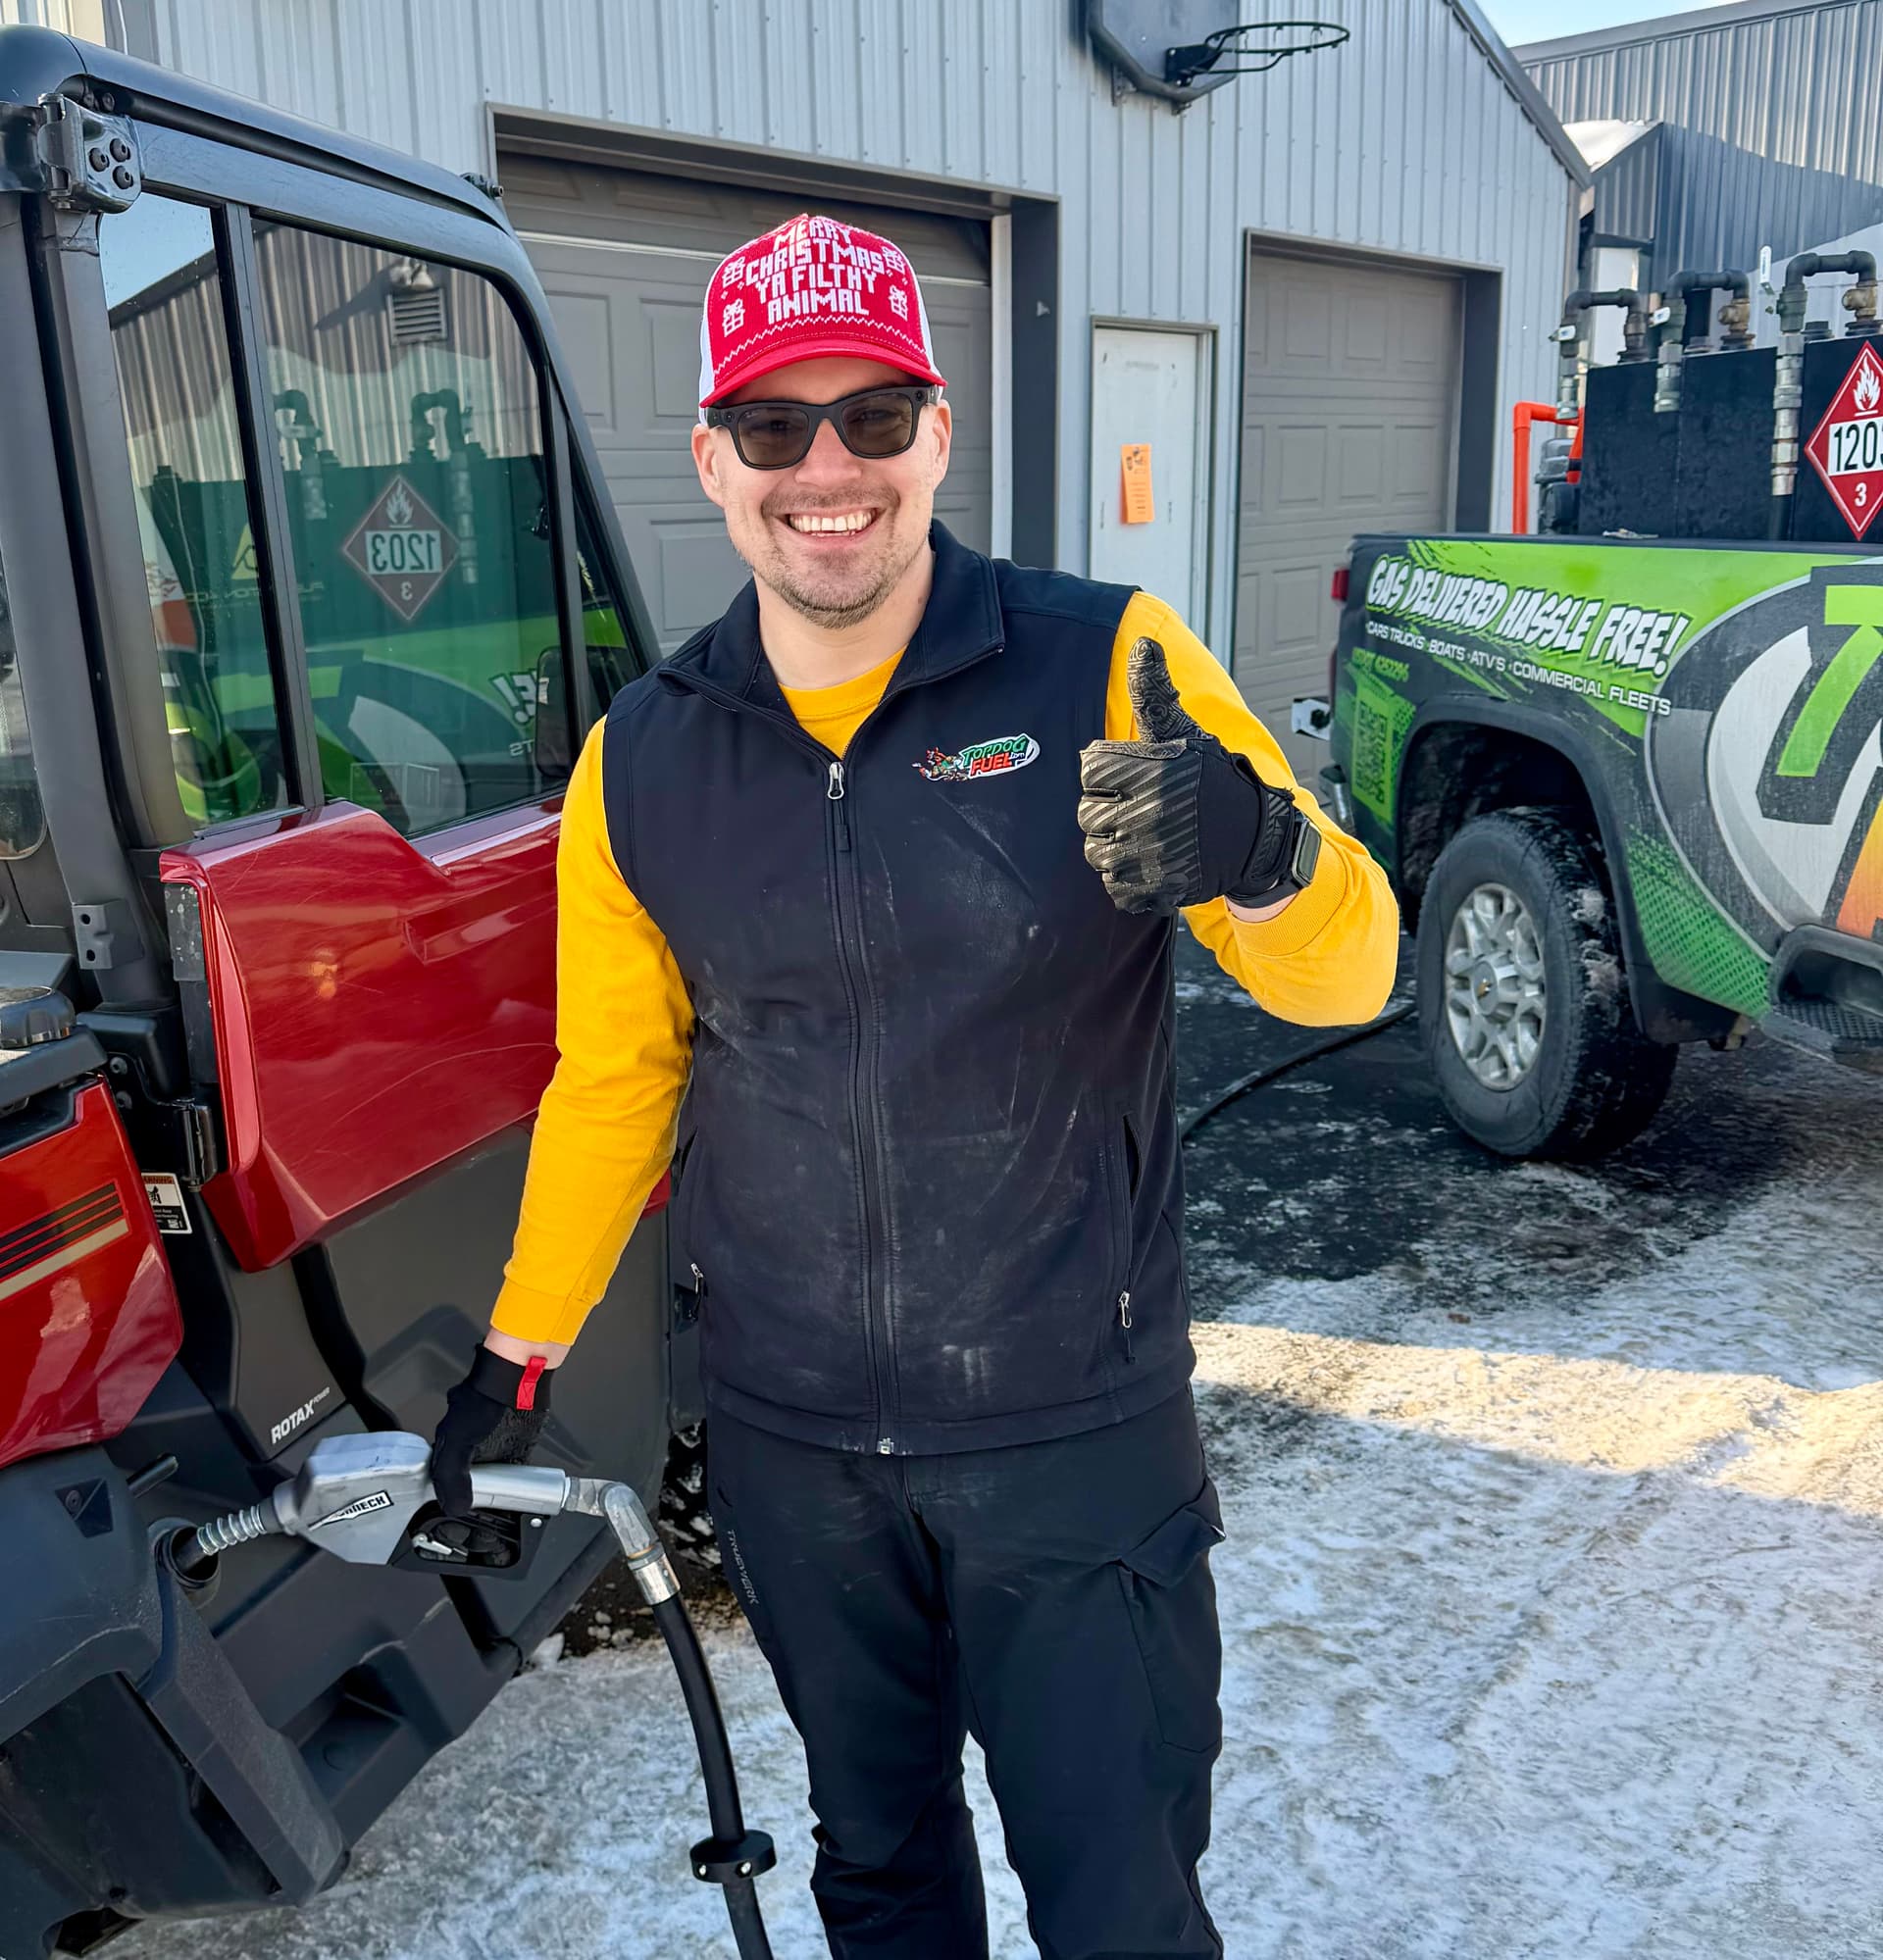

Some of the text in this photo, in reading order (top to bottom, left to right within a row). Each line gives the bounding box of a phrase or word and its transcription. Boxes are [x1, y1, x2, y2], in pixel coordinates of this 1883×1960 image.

[774, 219, 851, 251] MERRY
[745, 238, 884, 286] CHRISTMAS
[755, 264, 877, 304] YA FILTHY
[768, 290, 869, 325] ANIMAL
[1834, 422, 1883, 473] 120
[1855, 481, 1867, 508] 3
[1367, 557, 1691, 677] GAS DELIVERED HASSLE FREE!
[1366, 621, 1672, 716] CARS TRUCKS BOATS ATV'S COMMERCIAL FLEETS
[962, 736, 1028, 766] TOPDOG
[970, 751, 1012, 776] FUEL
[270, 1399, 314, 1444] ROTAX
